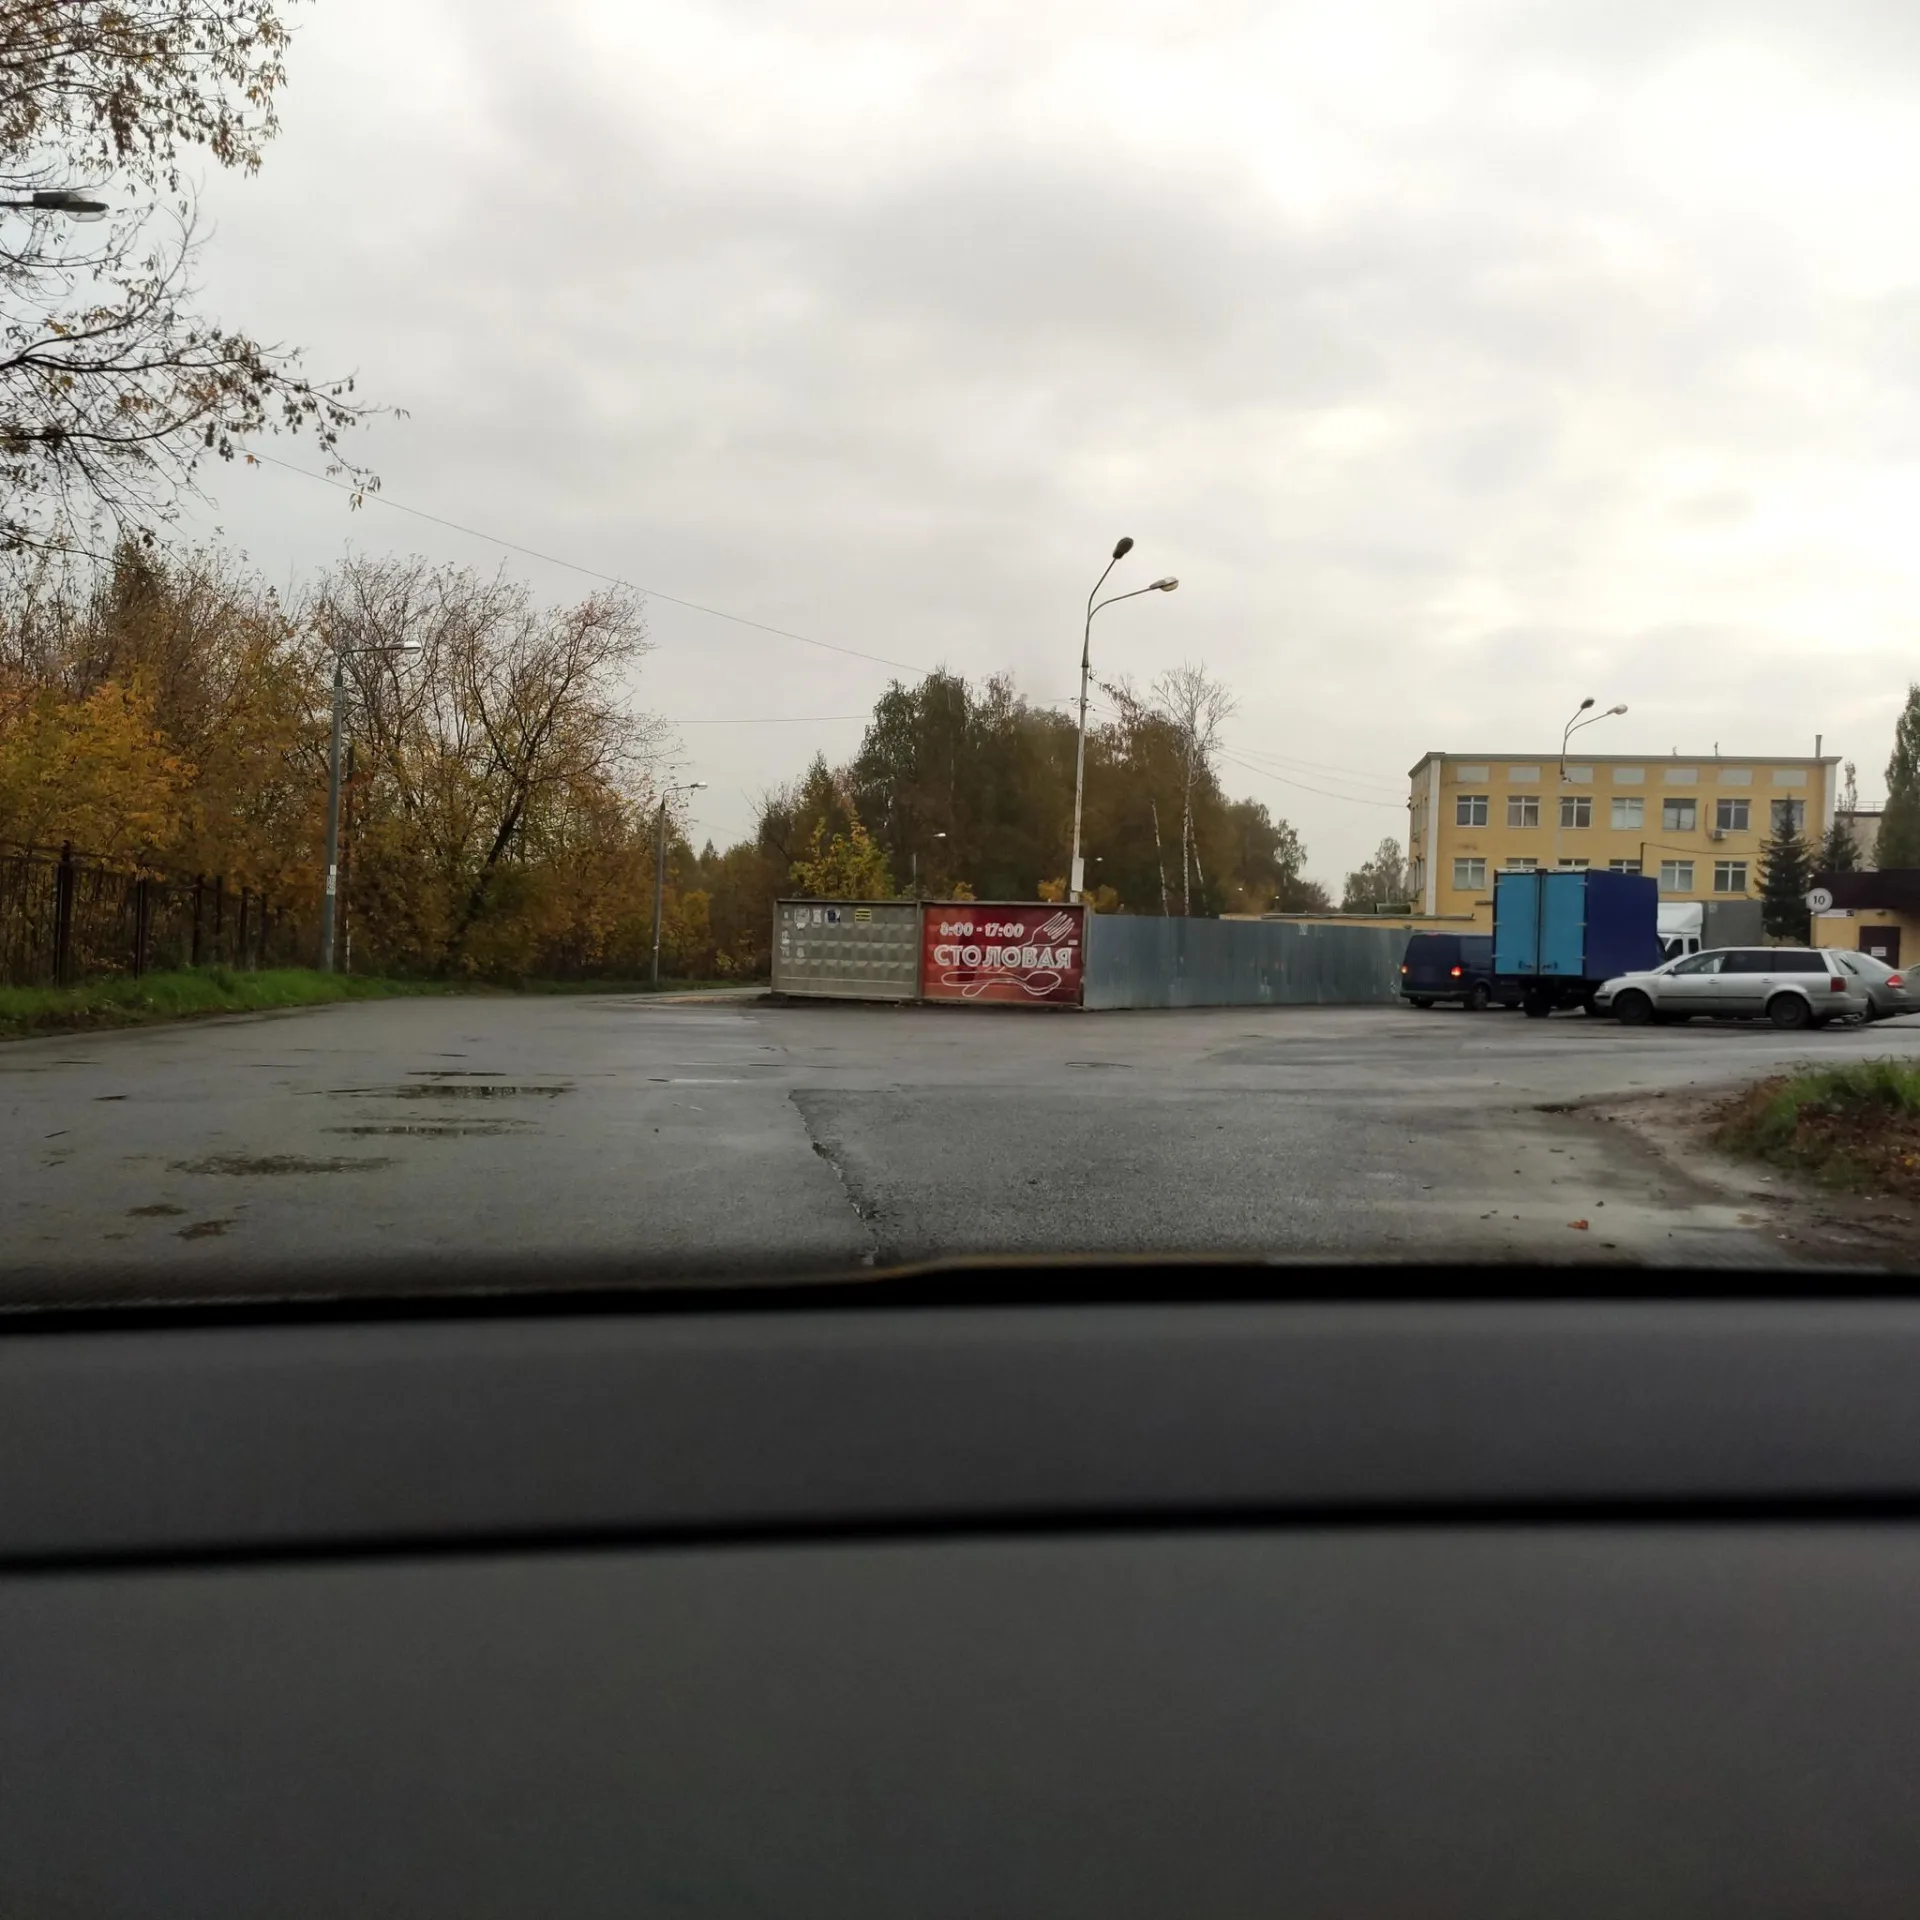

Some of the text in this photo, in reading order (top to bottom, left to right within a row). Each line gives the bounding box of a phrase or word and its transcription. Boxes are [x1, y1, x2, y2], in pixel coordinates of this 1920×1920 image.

[1813, 895, 1826, 905] 10
[939, 921, 973, 936] 8:00
[984, 922, 1024, 937] 17:00
[933, 944, 1072, 968] СТОЛОВАЯ
